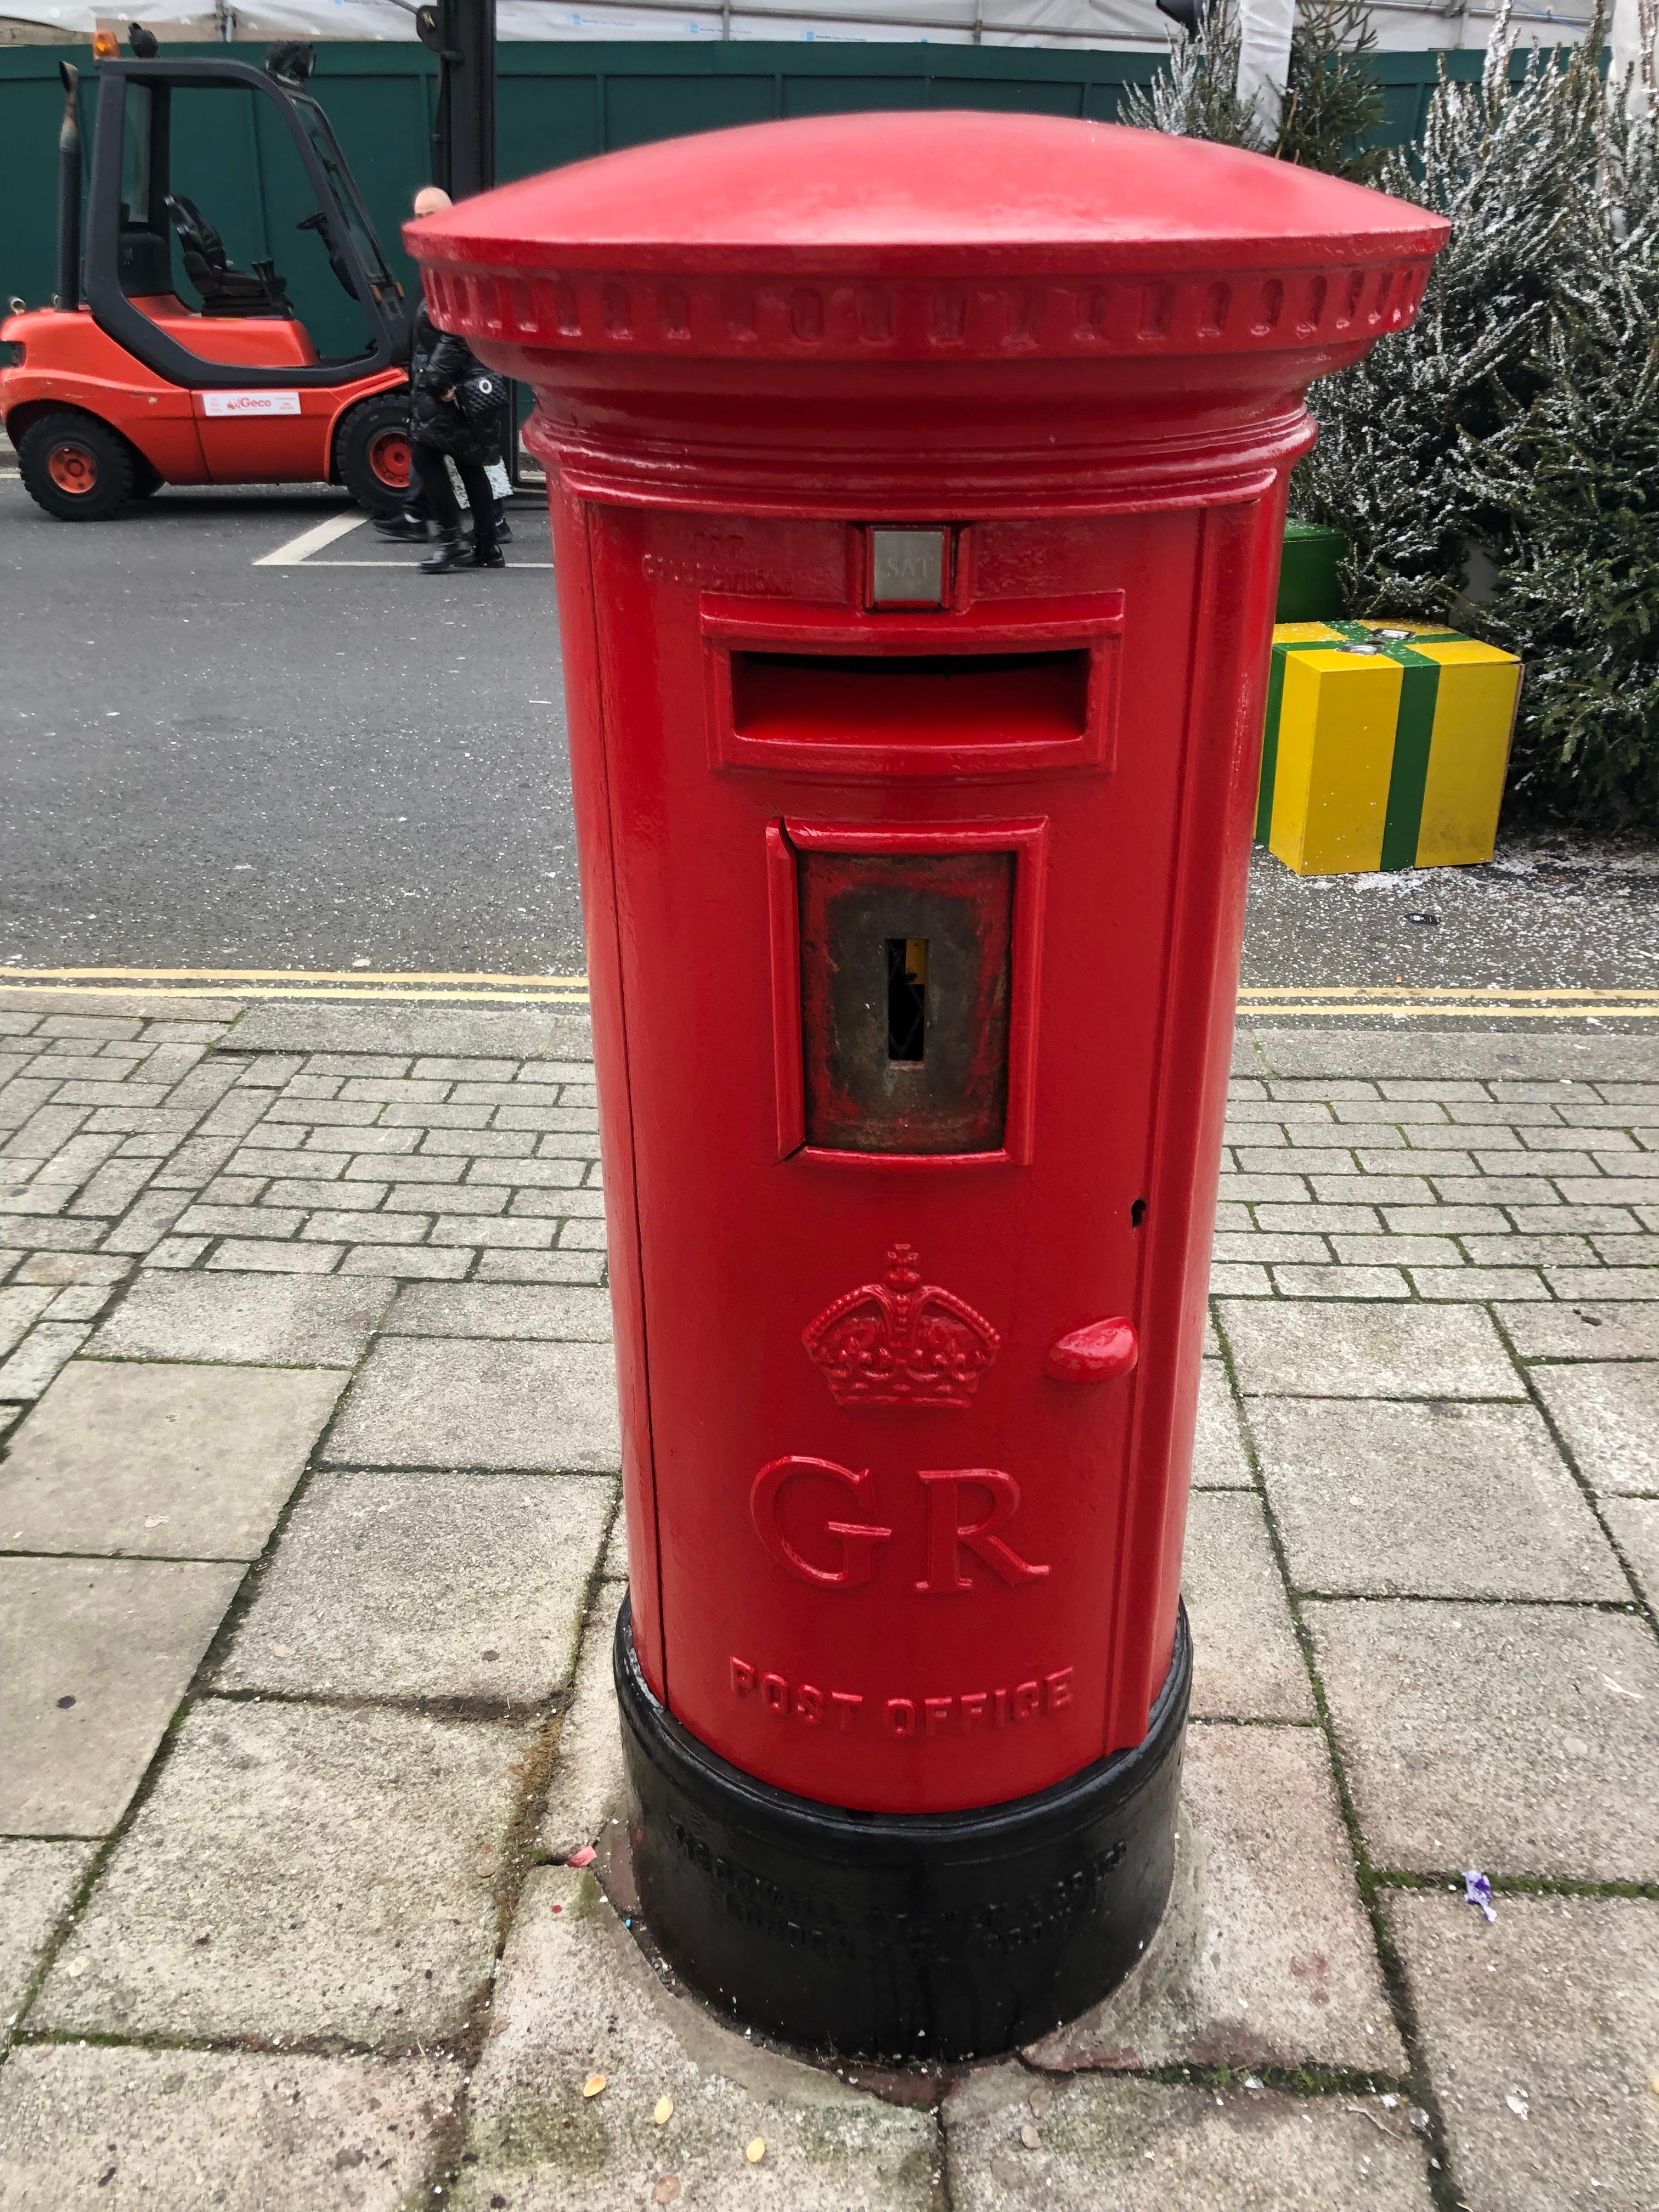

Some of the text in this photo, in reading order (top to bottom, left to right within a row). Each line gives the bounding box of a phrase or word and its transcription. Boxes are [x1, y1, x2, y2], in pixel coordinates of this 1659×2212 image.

[240, 397, 272, 409] Geco
[884, 556, 934, 578] SAT
[729, 1655, 1074, 1738] POST OFFICE
